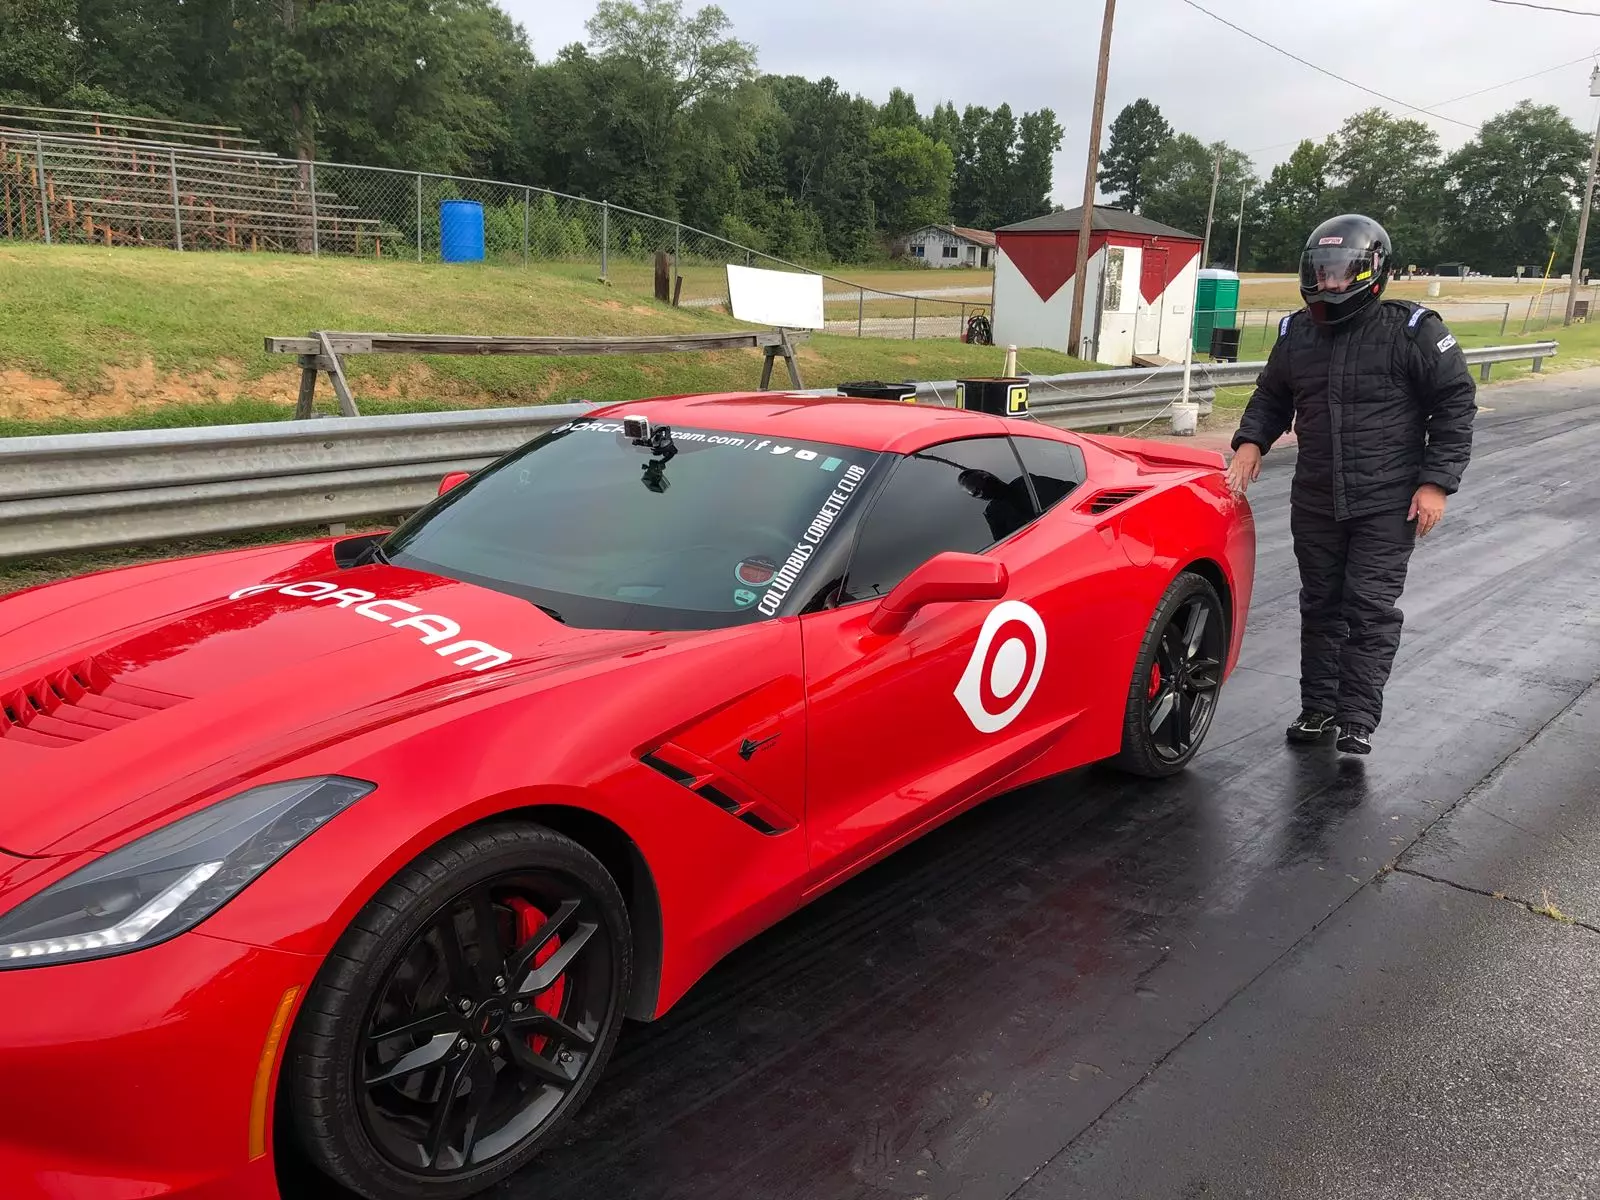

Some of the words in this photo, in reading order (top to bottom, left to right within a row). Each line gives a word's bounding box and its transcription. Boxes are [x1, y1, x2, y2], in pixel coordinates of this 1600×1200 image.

[669, 431, 744, 446] rcam.com
[758, 542, 813, 616] COLUMBUS
[803, 489, 848, 544] CORVETTE
[837, 464, 866, 493] CLUB
[278, 581, 512, 671] ORCAM
